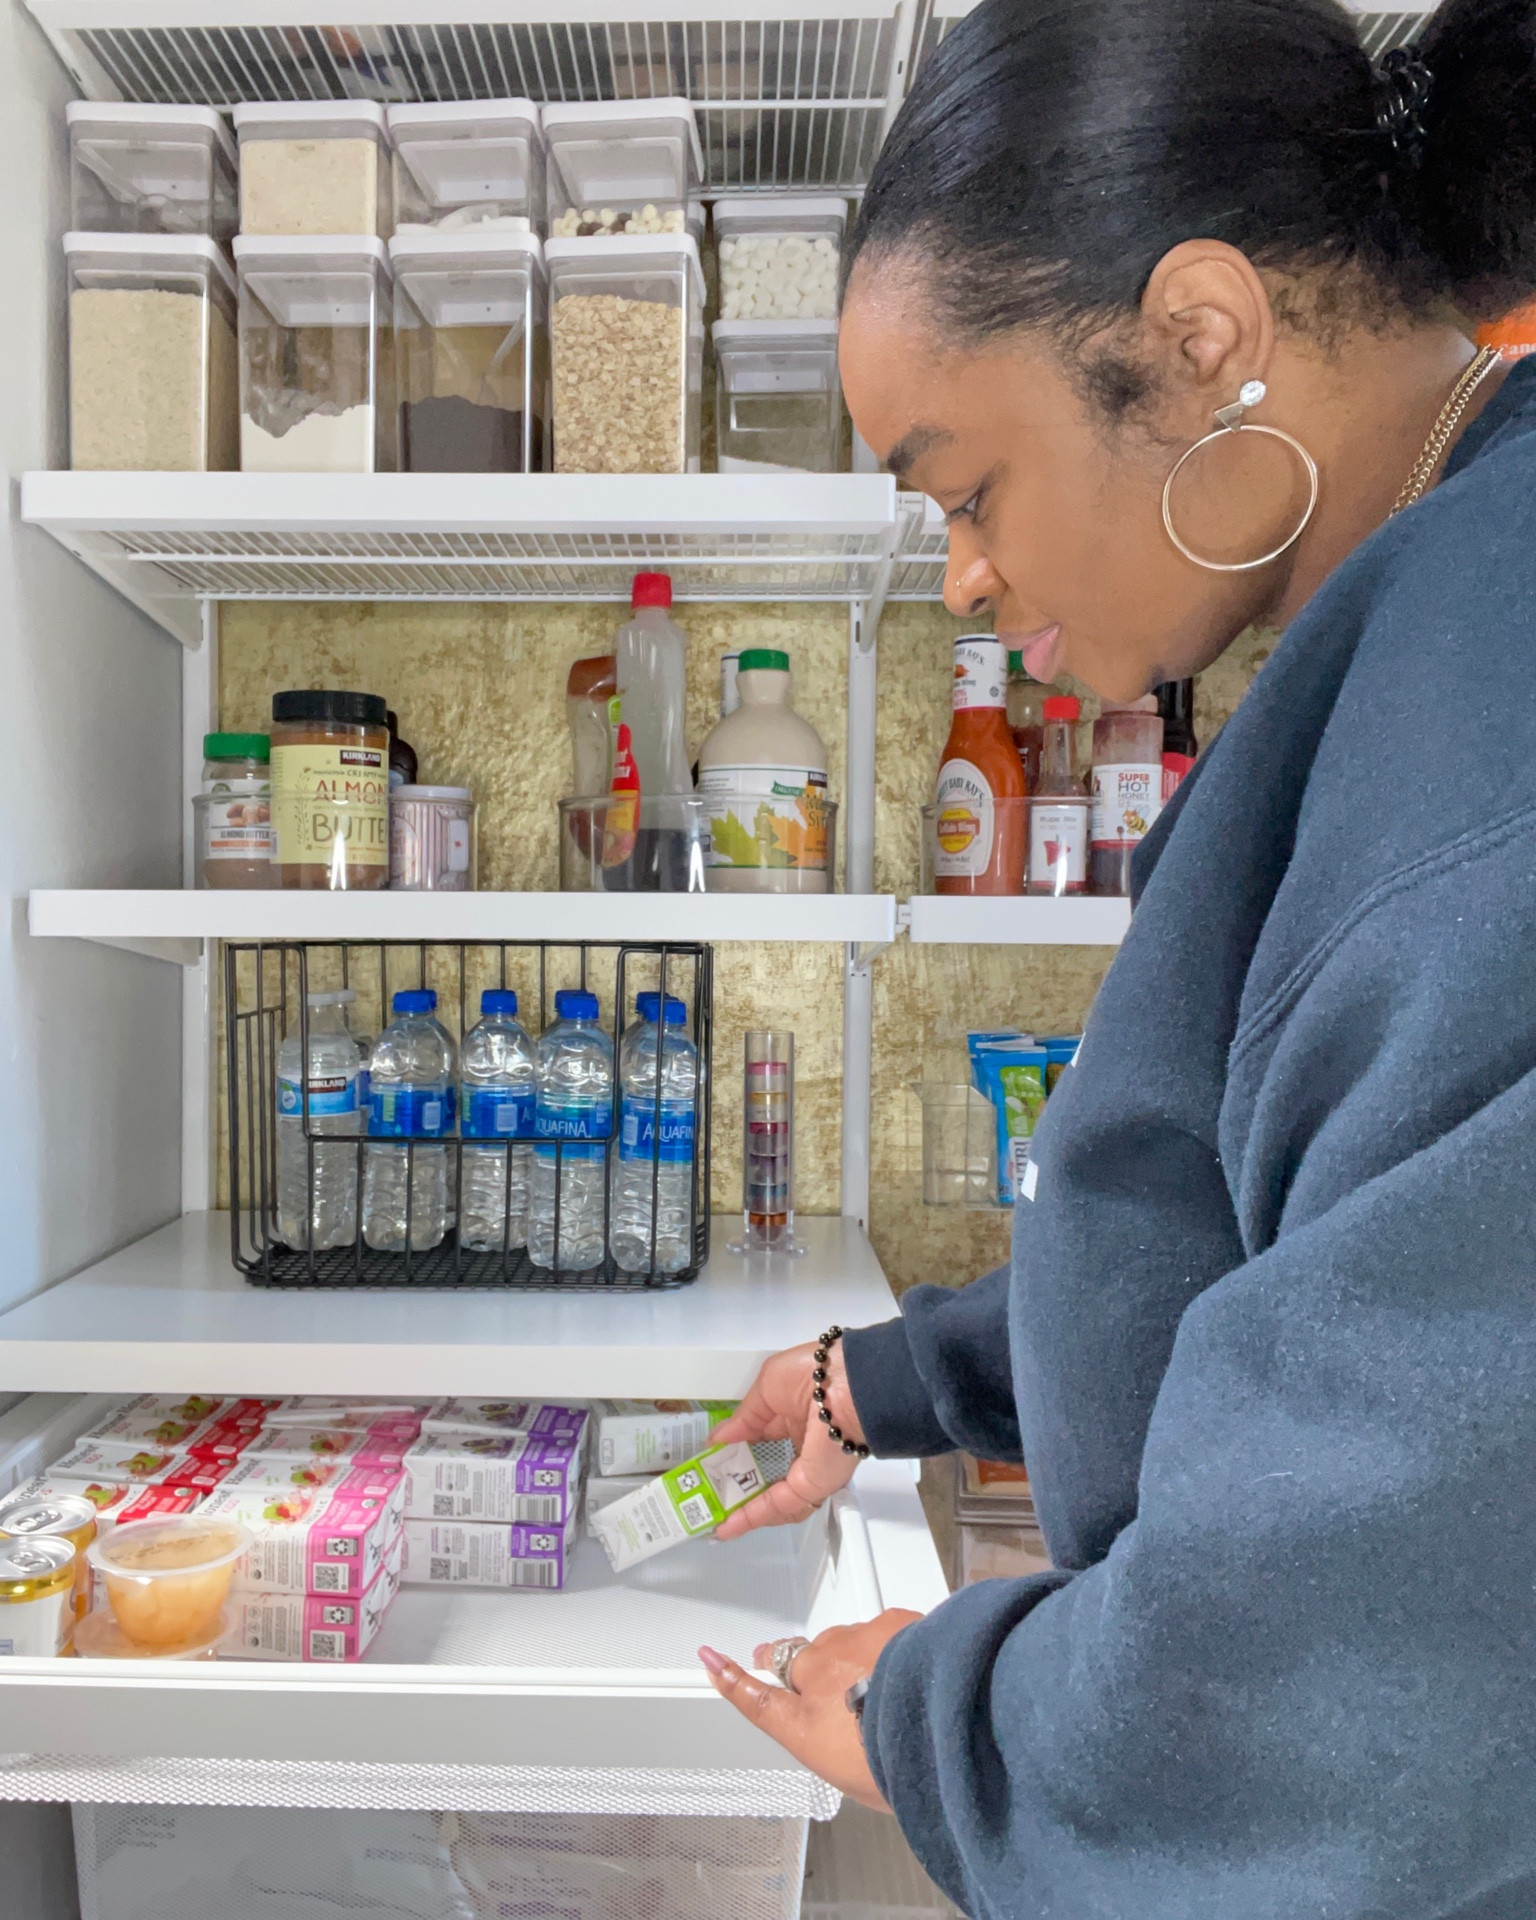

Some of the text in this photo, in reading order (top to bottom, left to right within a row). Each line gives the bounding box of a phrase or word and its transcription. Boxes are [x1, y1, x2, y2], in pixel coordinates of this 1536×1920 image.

[342, 751, 381, 762] KIRKLAND
[1118, 772, 1150, 783] SUPER
[1118, 781, 1150, 792] HOT
[1118, 792, 1150, 800] HONEY
[224, 1458, 262, 1486] Honest
